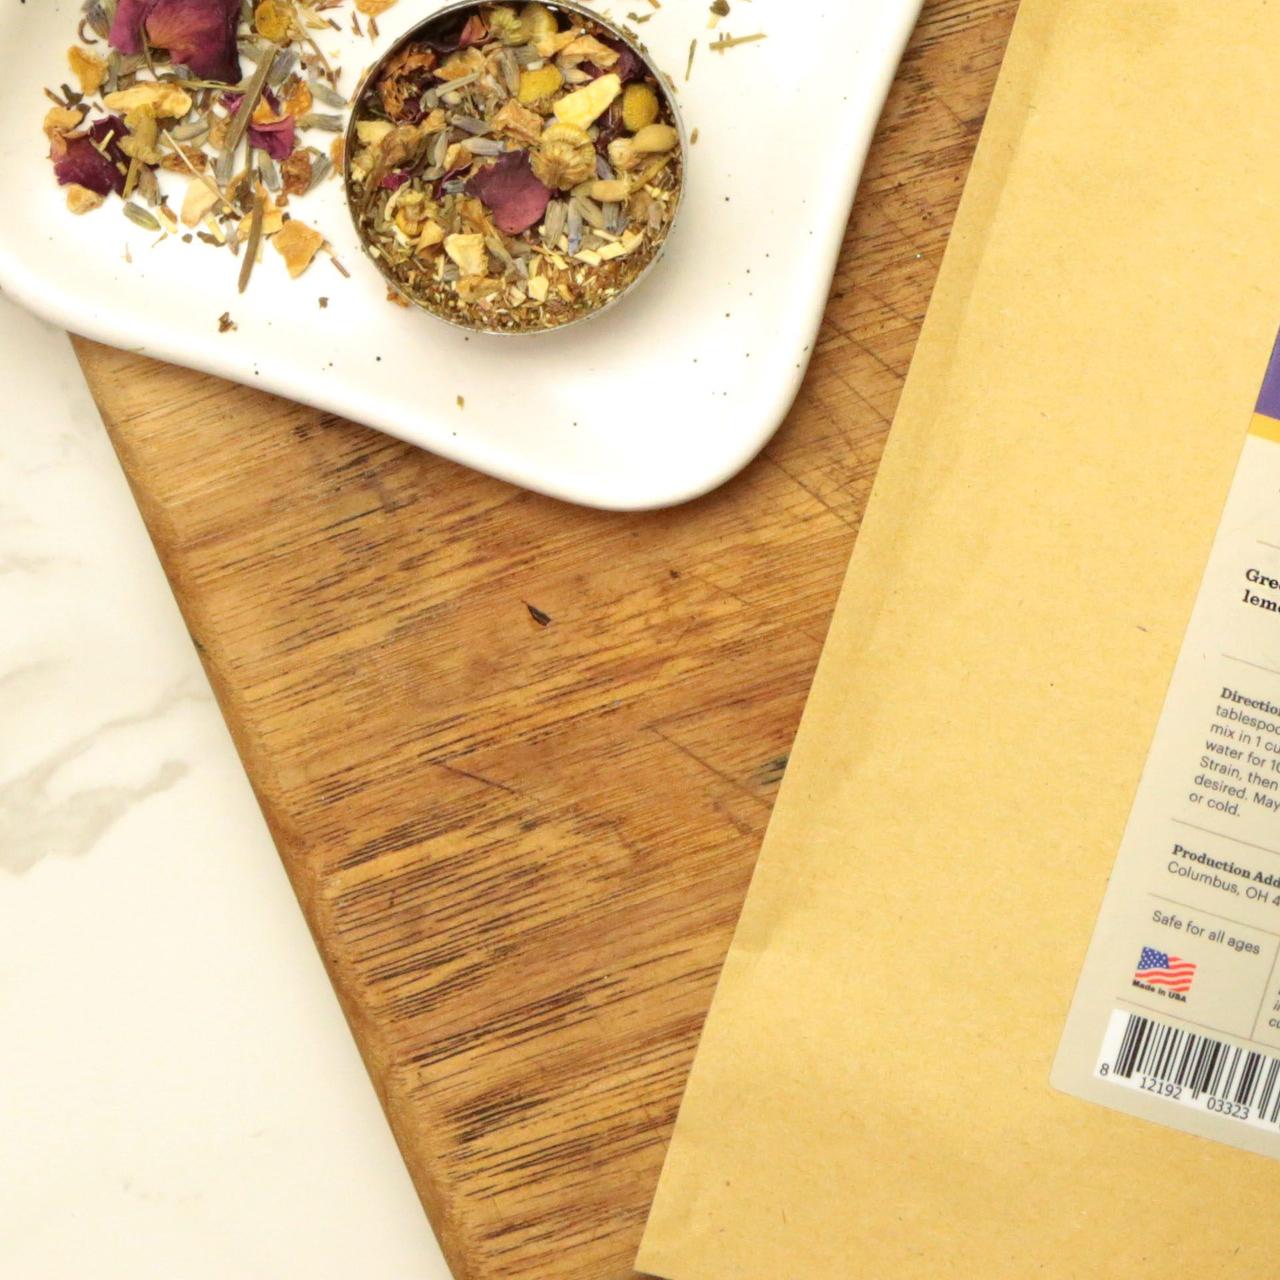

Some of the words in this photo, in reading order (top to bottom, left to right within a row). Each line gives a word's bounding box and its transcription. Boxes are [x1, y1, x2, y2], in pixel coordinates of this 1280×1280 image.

[1209, 723, 1236, 740] mix
[1237, 729, 1252, 745] in
[1255, 734, 1262, 748] 1
[1205, 740, 1244, 761] water
[1246, 750, 1267, 768] for
[1193, 773, 1248, 801] desired.
[1199, 755, 1243, 781] Strain,
[1246, 771, 1279, 791] then
[1187, 791, 1204, 804] or
[1206, 798, 1240, 817] cold.
[1171, 843, 1251, 880] Production
[1166, 860, 1240, 897] Columbus,
[1244, 885, 1269, 904] OH
[1151, 909, 1183, 930] Safe
[1185, 919, 1206, 937] for
[1207, 929, 1226, 944] all
[1226, 936, 1261, 955] ages
[1131, 978, 1156, 993] Made
[1156, 987, 1167, 997] in
[1167, 990, 1187, 1003] USA
[1098, 1062, 1110, 1077] 8
[1139, 1075, 1183, 1100] 12192
[1205, 1095, 1250, 1121] 03323
